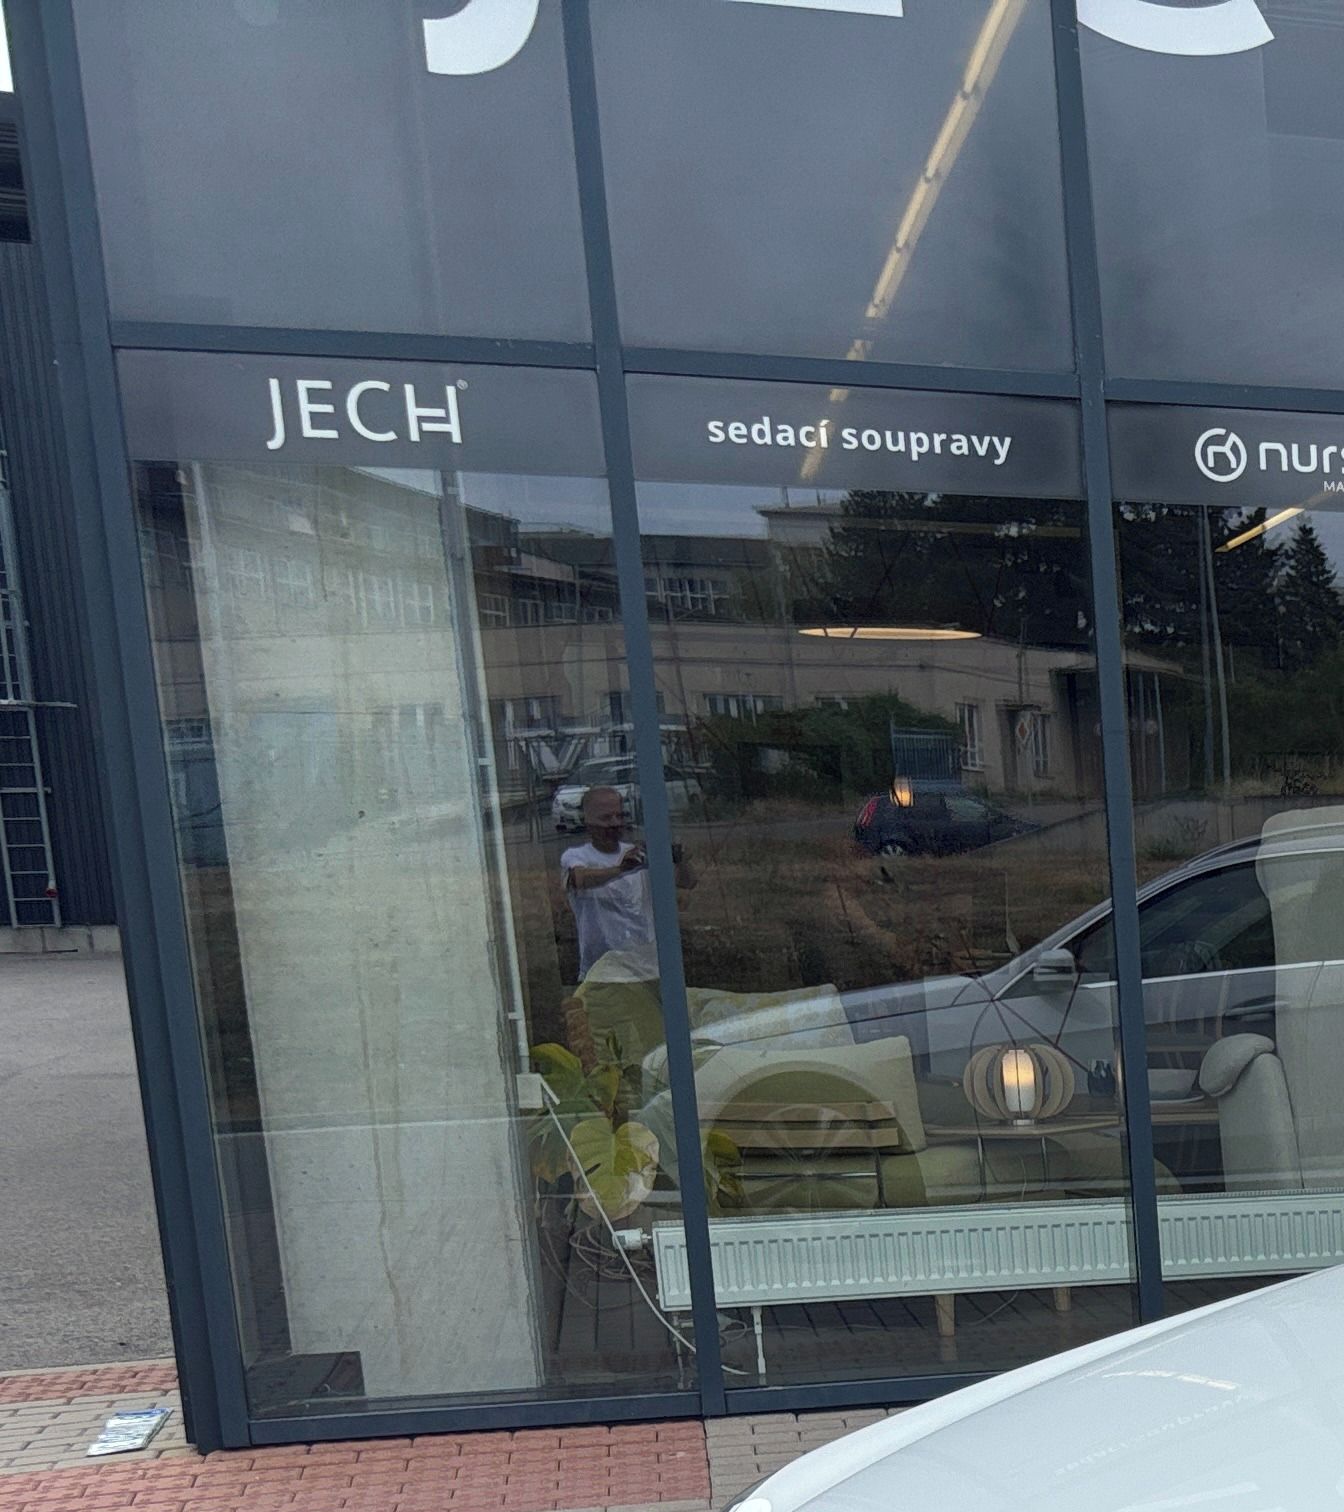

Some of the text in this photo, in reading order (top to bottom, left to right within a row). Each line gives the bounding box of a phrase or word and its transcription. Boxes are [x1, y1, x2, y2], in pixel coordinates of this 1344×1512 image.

[265, 377, 463, 450] JECH
[706, 416, 1012, 466] sedací soupravy
